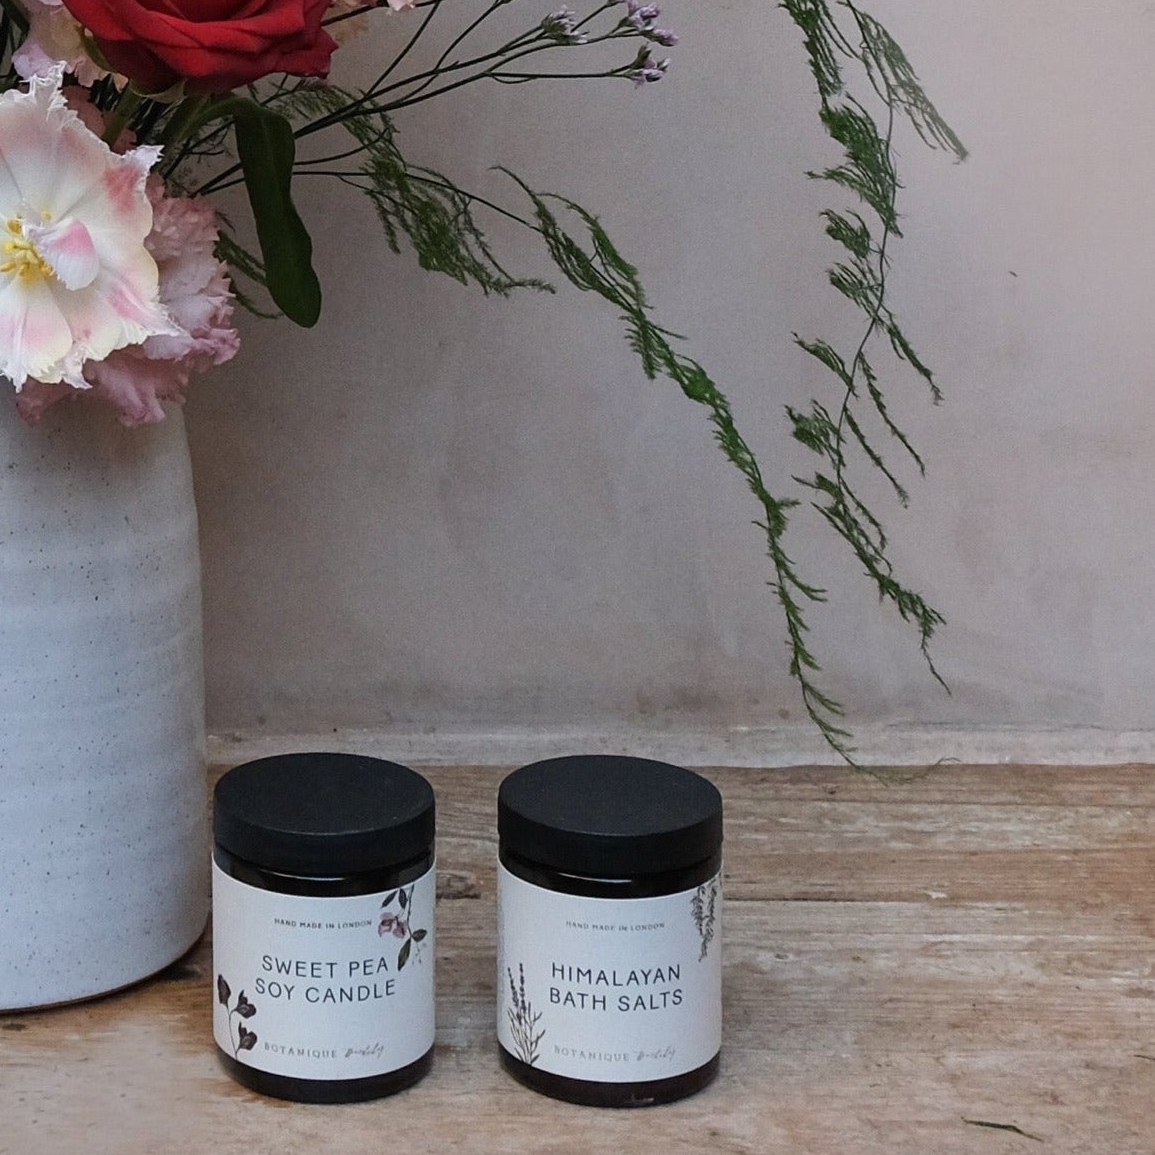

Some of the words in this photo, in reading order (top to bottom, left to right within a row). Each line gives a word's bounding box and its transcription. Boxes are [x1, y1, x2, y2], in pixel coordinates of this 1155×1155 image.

[274, 918, 297, 927] HAND
[338, 919, 372, 929] LONDON
[565, 921, 589, 929] HAND
[630, 922, 665, 931] LONDON
[262, 955, 338, 978] SWEET
[349, 957, 388, 977] PEA
[552, 962, 680, 986] HIMALAYAN
[255, 977, 295, 1000] SOY
[305, 979, 395, 1003] CANDLE
[550, 987, 606, 1011] BATH
[618, 989, 683, 1012] SALTS
[264, 1042, 337, 1058] BOTANIQUE
[554, 1045, 629, 1062] BOTANIQUE
